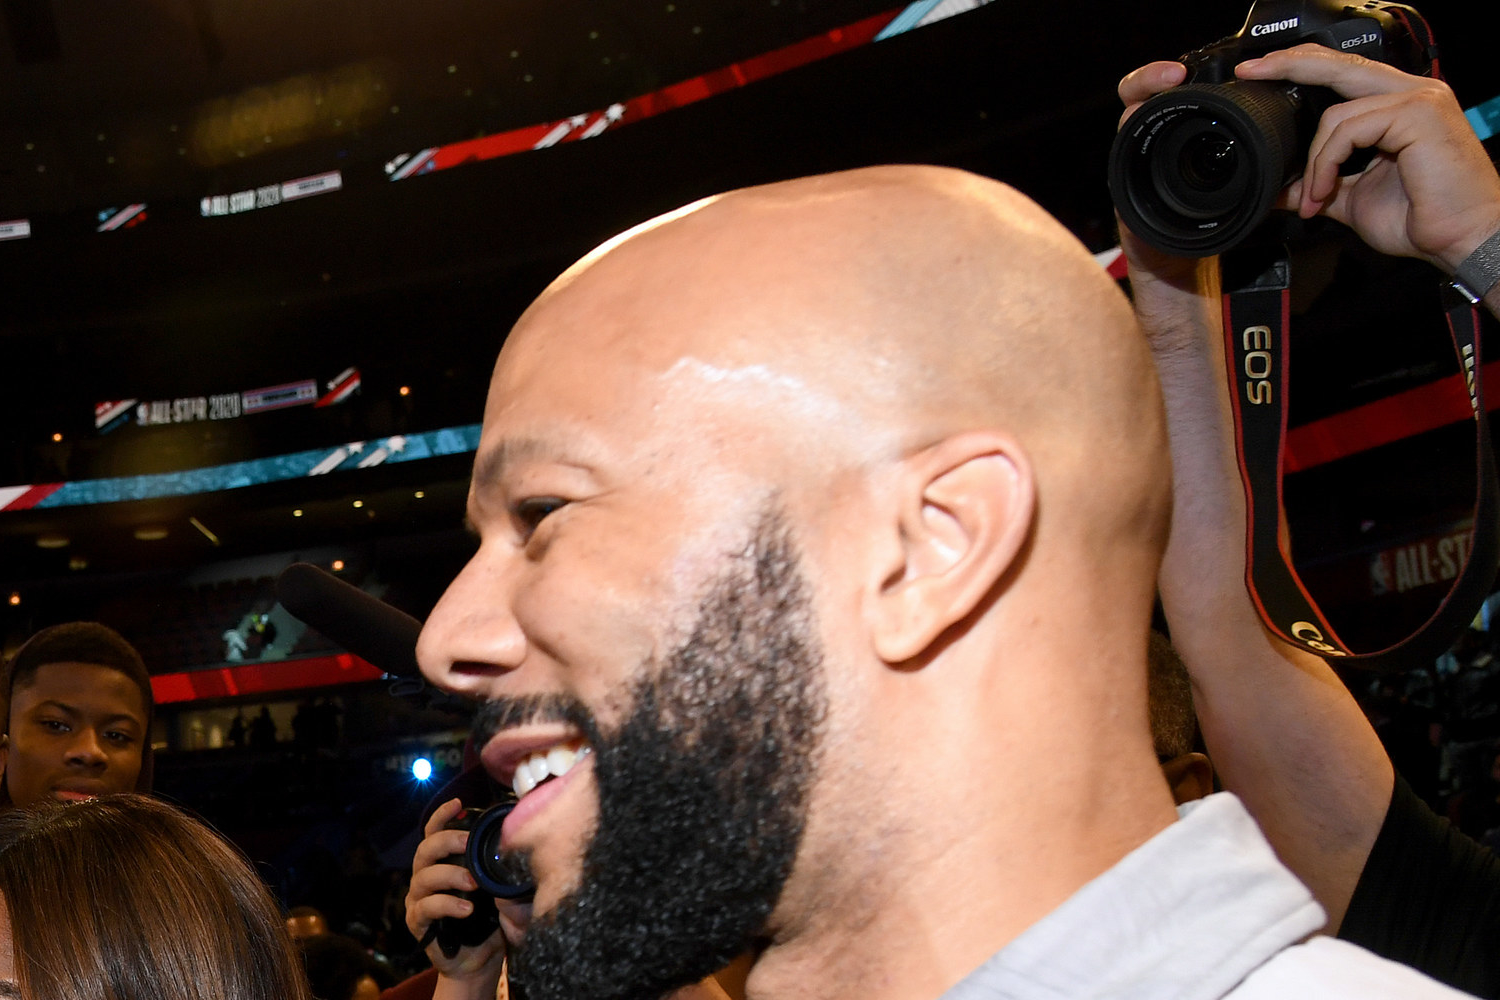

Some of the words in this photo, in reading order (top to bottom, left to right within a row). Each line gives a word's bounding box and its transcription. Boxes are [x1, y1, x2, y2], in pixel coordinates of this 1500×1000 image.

[1251, 17, 1299, 37] Canon
[1243, 325, 1272, 405] EOS
[209, 392, 242, 421] 2020
